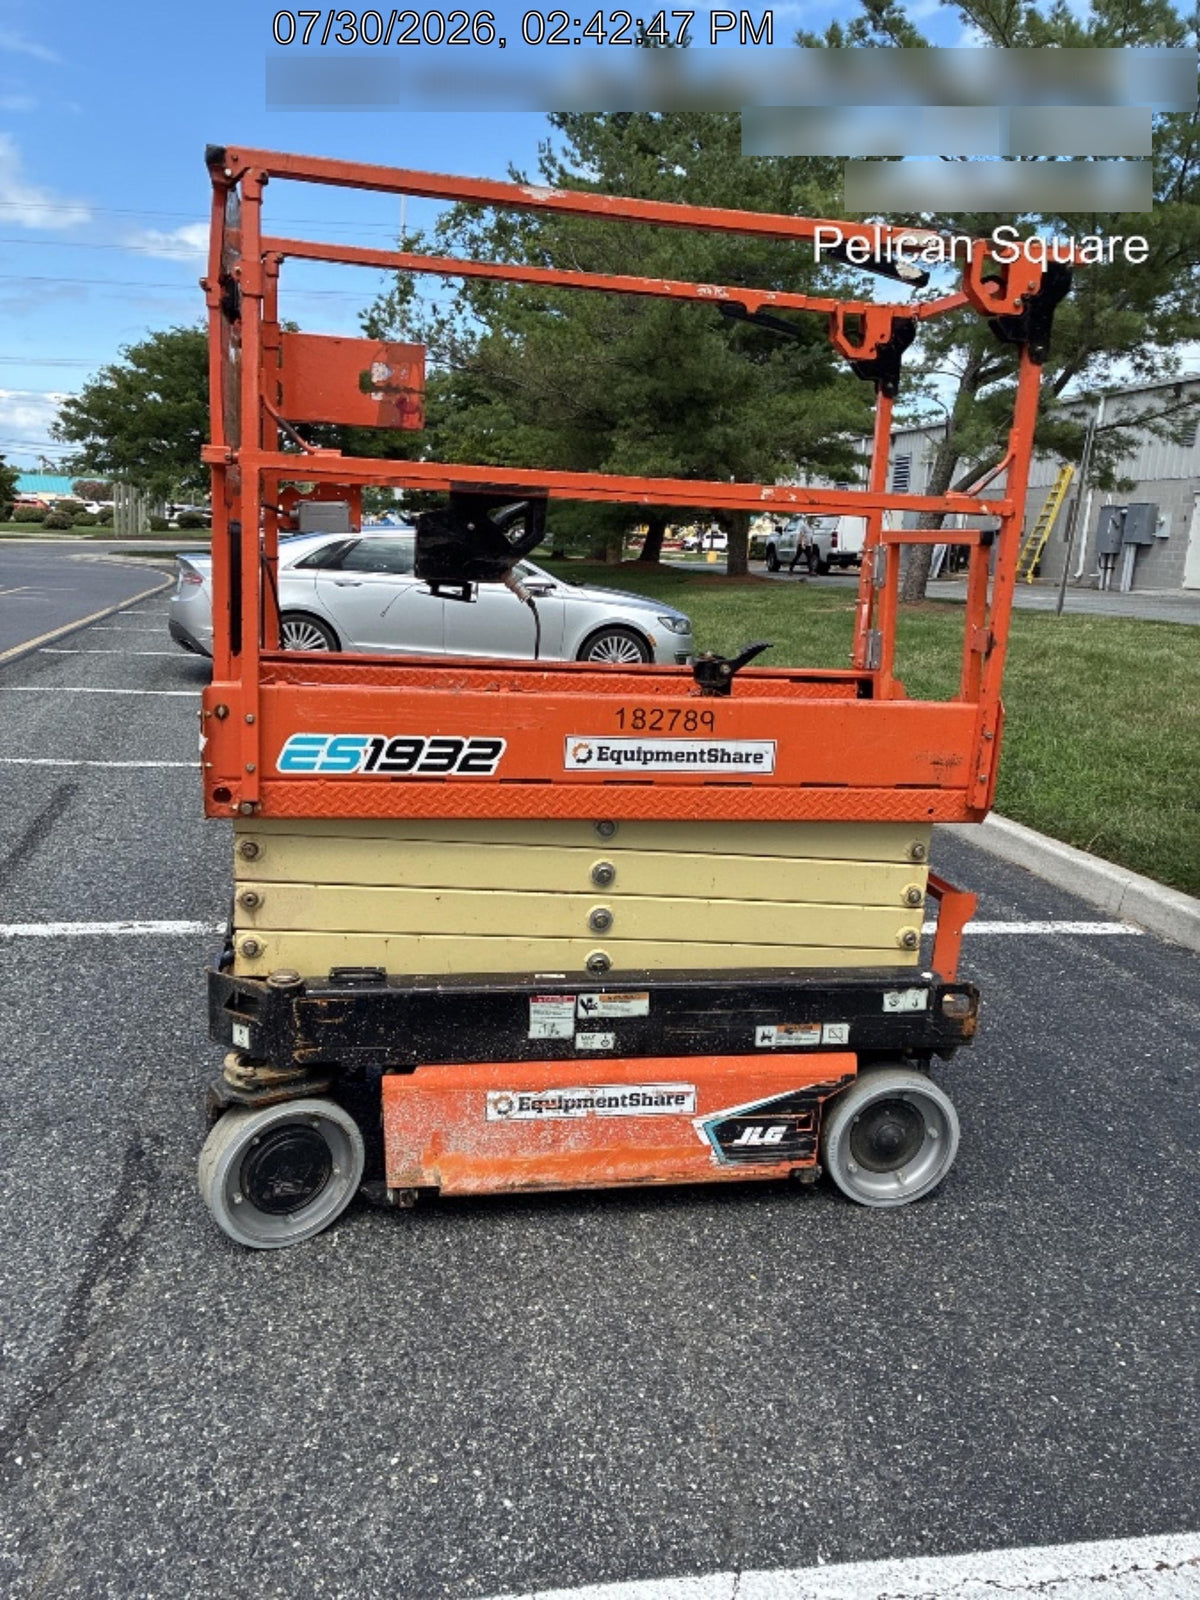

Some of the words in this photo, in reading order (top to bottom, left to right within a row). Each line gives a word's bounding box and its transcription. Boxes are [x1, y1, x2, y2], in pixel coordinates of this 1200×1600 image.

[615, 707, 715, 732] 182789
[278, 735, 504, 774] ES1932
[596, 745, 764, 765] EquipmentShare
[733, 1125, 788, 1146] JLG
